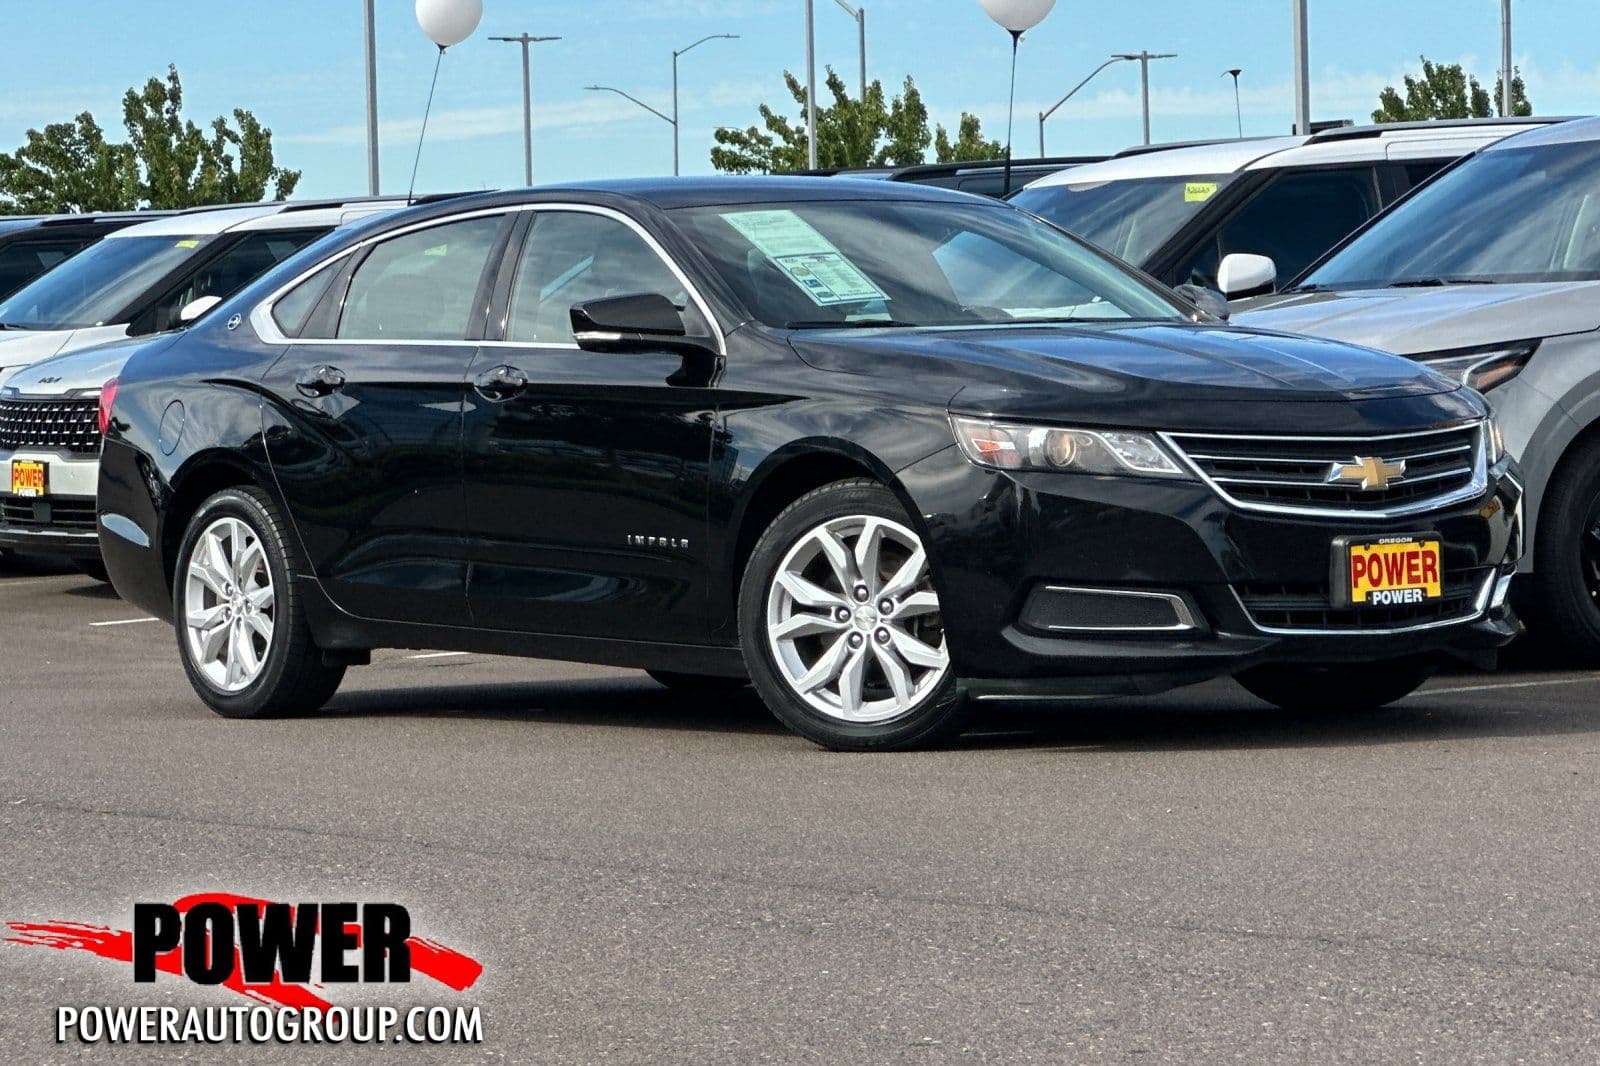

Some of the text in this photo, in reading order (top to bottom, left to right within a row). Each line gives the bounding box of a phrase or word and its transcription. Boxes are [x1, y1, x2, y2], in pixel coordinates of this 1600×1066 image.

[13, 468, 44, 487] POWER
[627, 534, 689, 548] IMPALA
[1351, 549, 1439, 589] POWER
[1372, 588, 1423, 605] POWER
